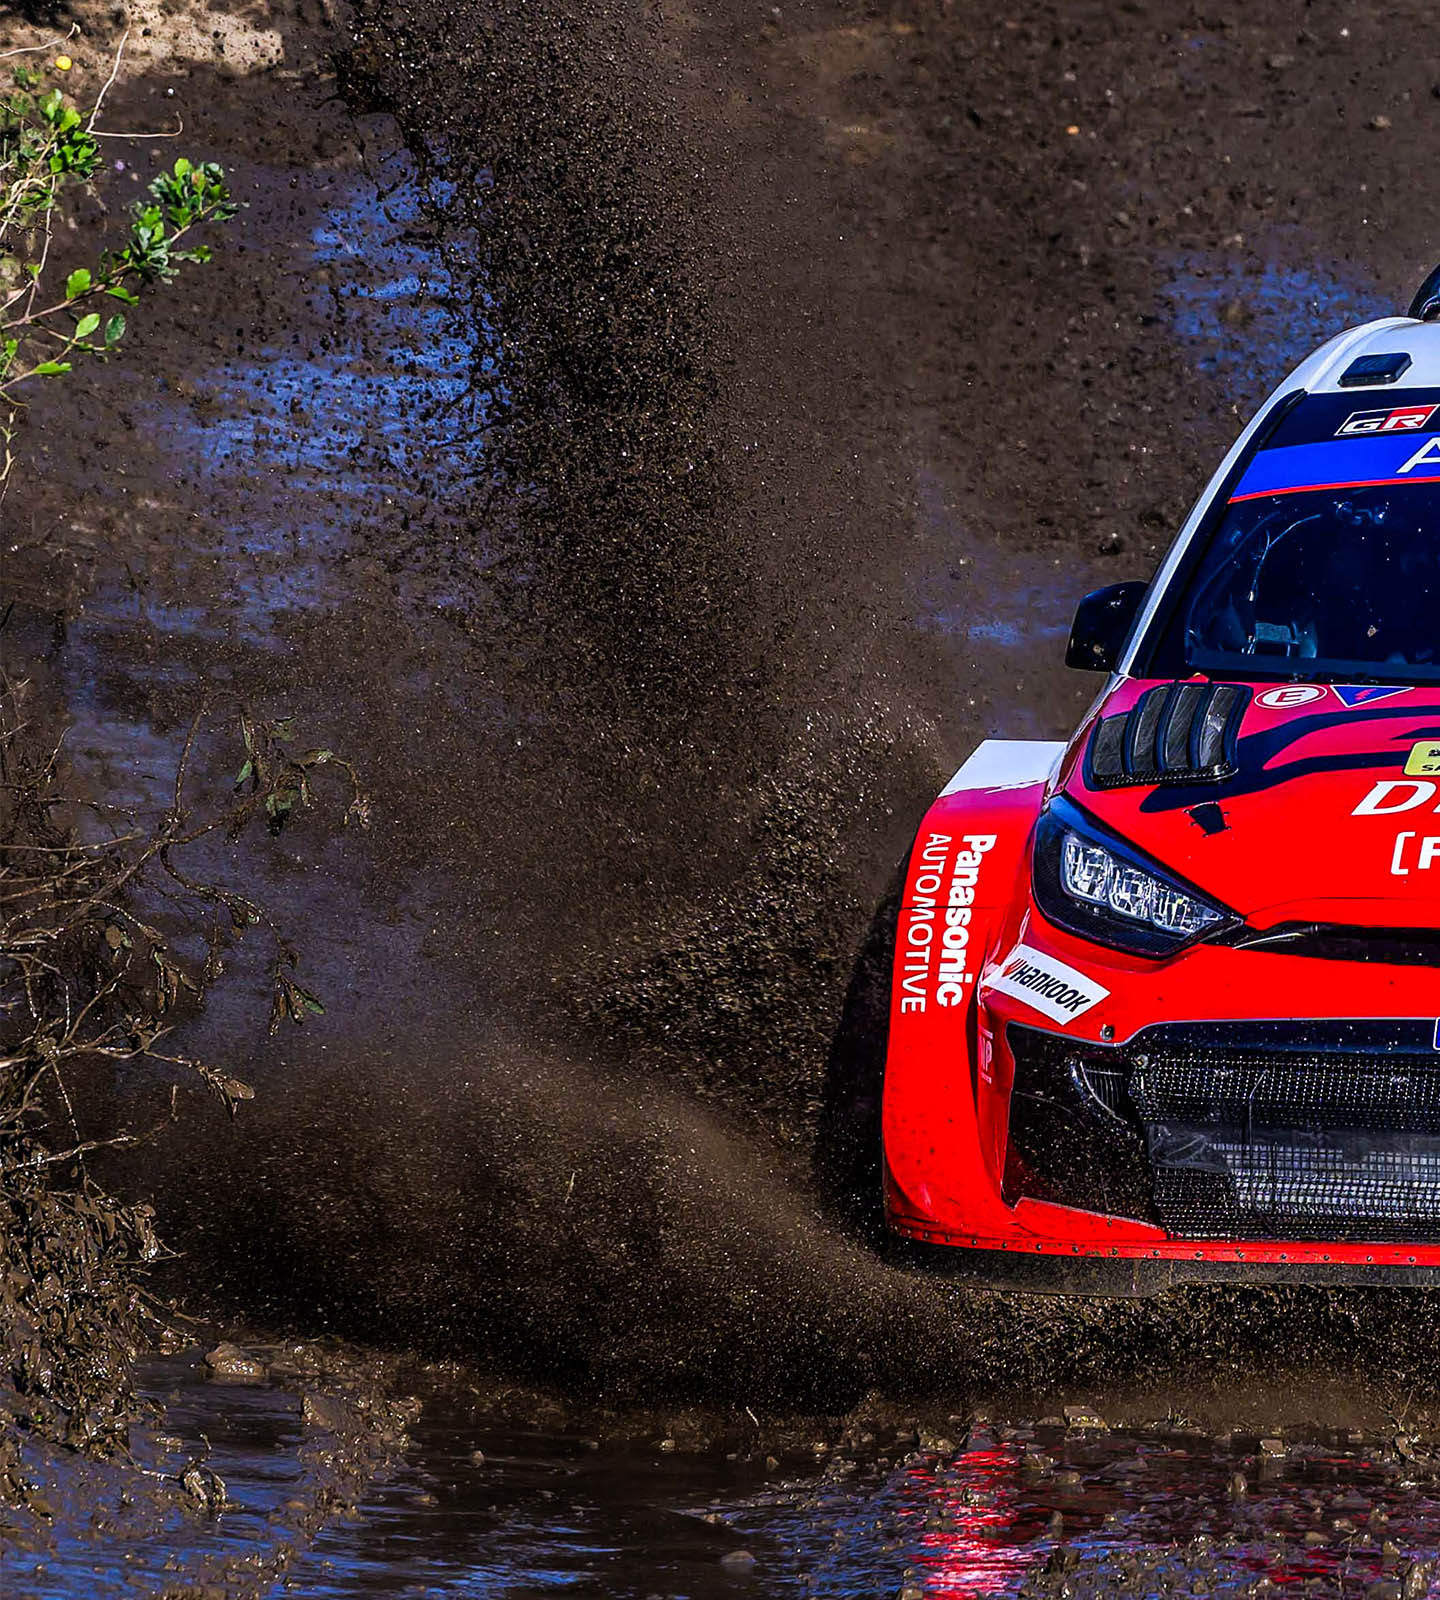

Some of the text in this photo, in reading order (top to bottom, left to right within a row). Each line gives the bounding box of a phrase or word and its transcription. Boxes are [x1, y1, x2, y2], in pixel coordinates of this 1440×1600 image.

[1340, 411, 1428, 433] GR
[901, 832, 952, 1014] AUTOMOTIVE
[936, 834, 998, 1008] Panasonic
